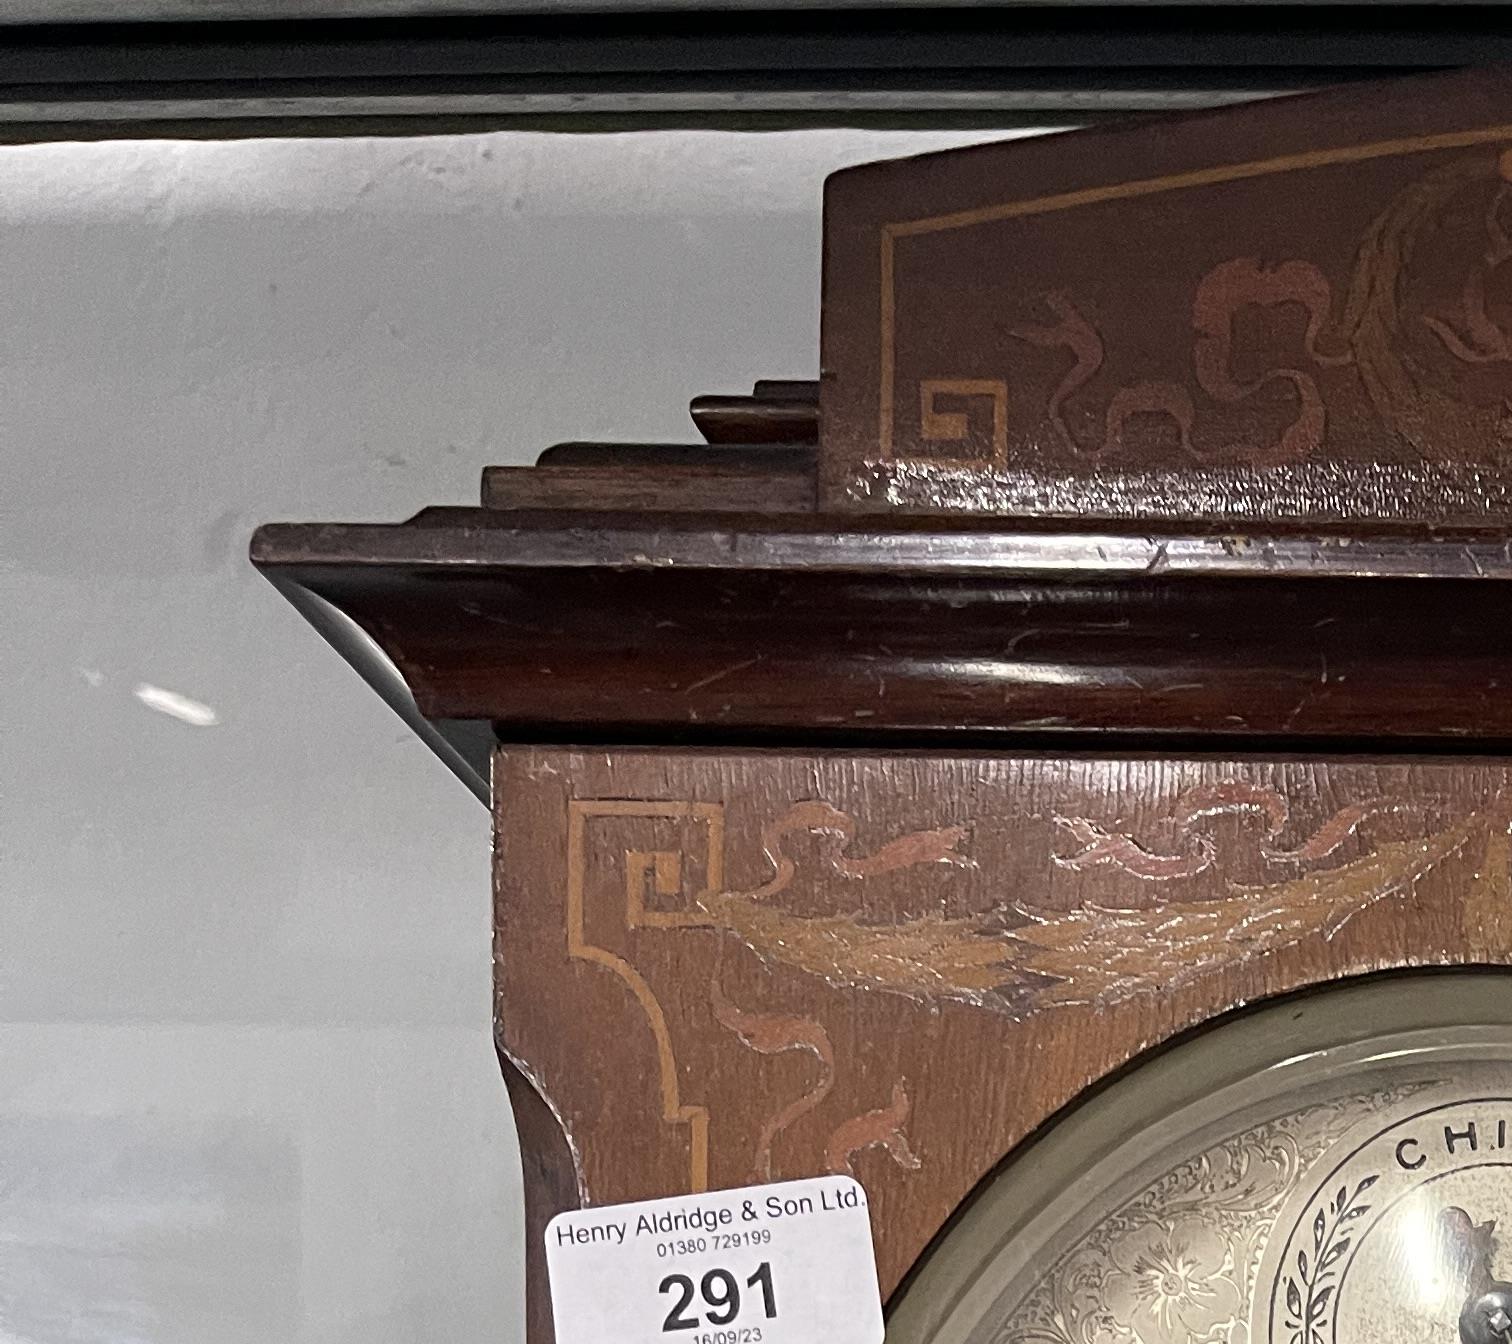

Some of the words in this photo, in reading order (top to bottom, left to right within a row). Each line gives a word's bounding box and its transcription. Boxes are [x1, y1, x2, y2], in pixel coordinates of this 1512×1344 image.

[557, 1222, 627, 1247] Henry
[636, 1207, 733, 1236] Aldridge
[741, 1201, 758, 1221] &
[766, 1196, 813, 1218] Son
[821, 1186, 866, 1211] Ltd.
[657, 1239, 707, 1257] 01380
[712, 1229, 772, 1250] 729199
[658, 1262, 777, 1332] 291
